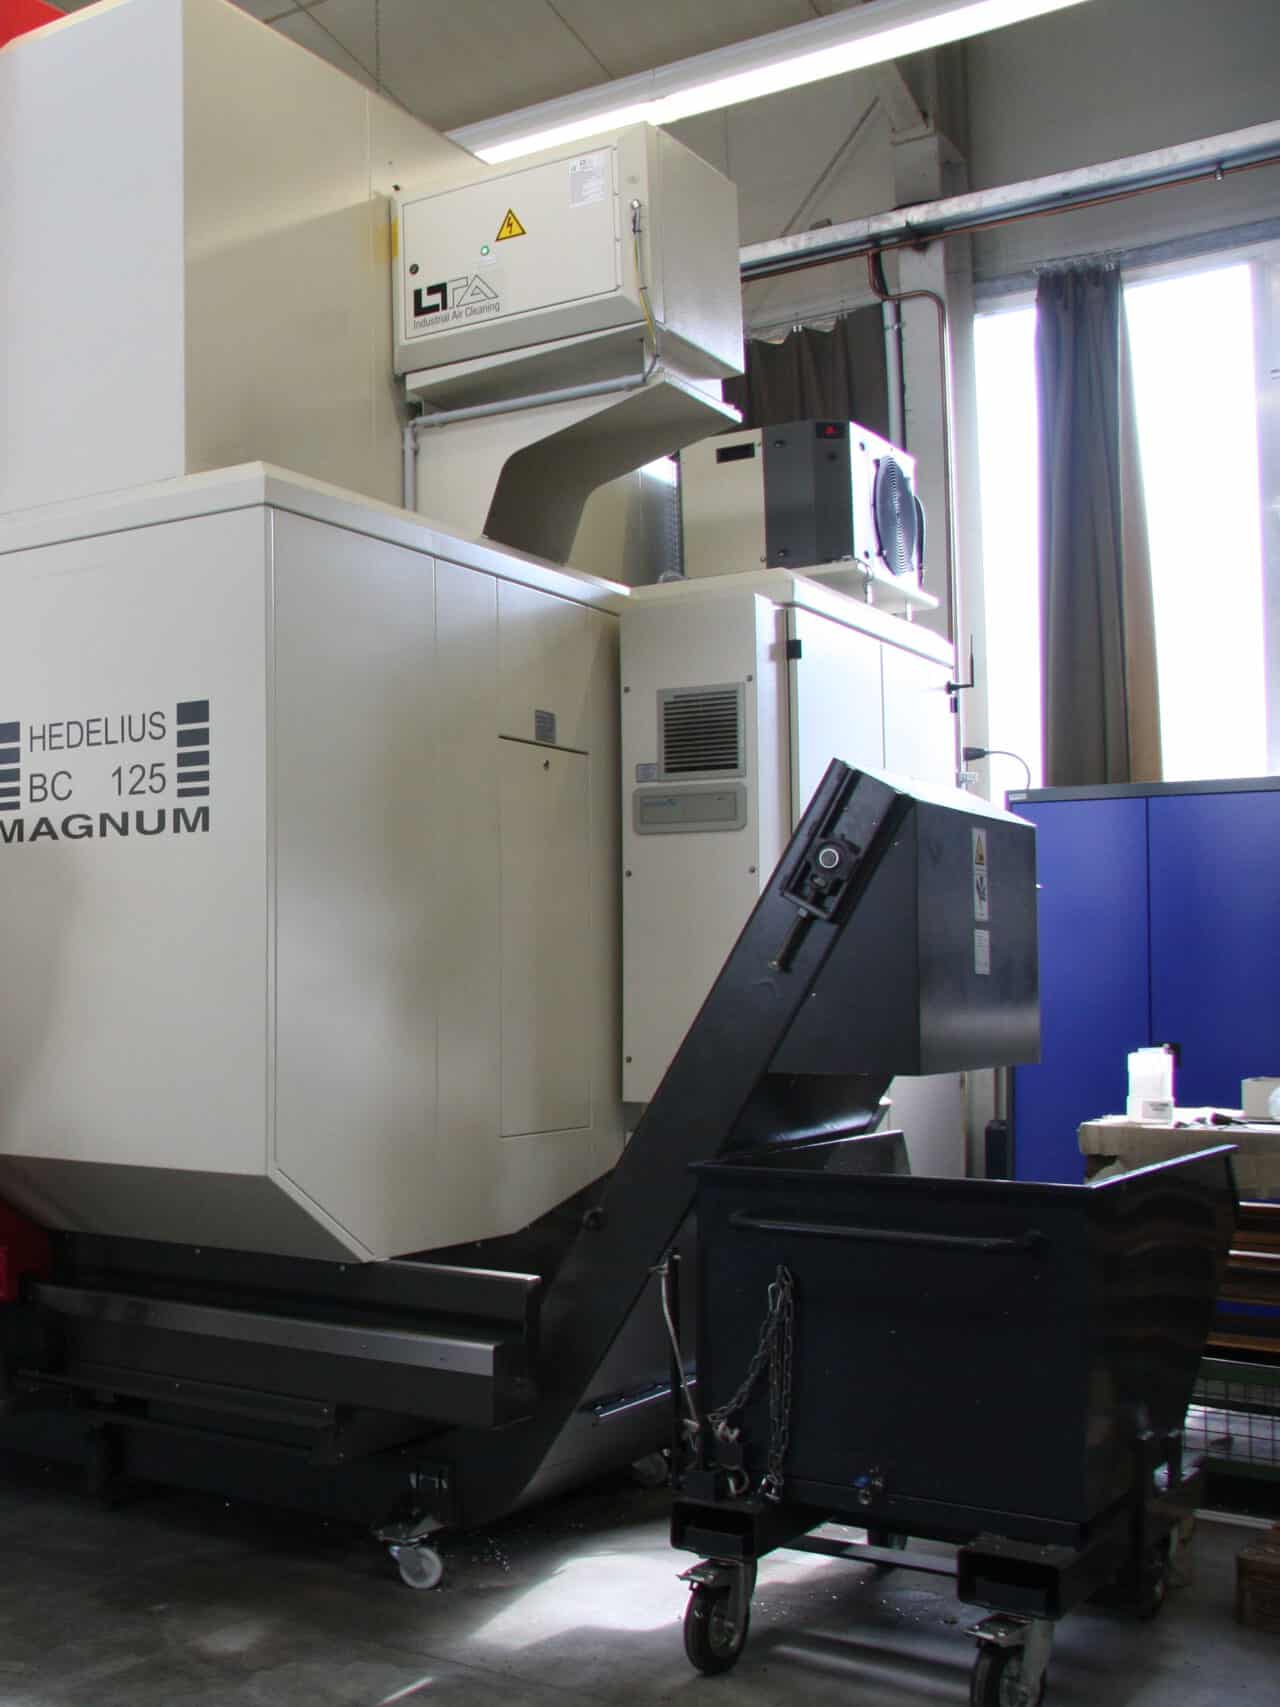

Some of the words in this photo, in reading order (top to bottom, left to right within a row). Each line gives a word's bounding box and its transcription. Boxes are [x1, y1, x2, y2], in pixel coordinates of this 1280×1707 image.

[414, 313, 450, 329] Industrial
[451, 309, 463, 320] Air
[465, 302, 501, 317] Cleaning
[29, 711, 167, 752] HEDELIUS
[29, 770, 73, 803] BC
[111, 762, 167, 796] 125
